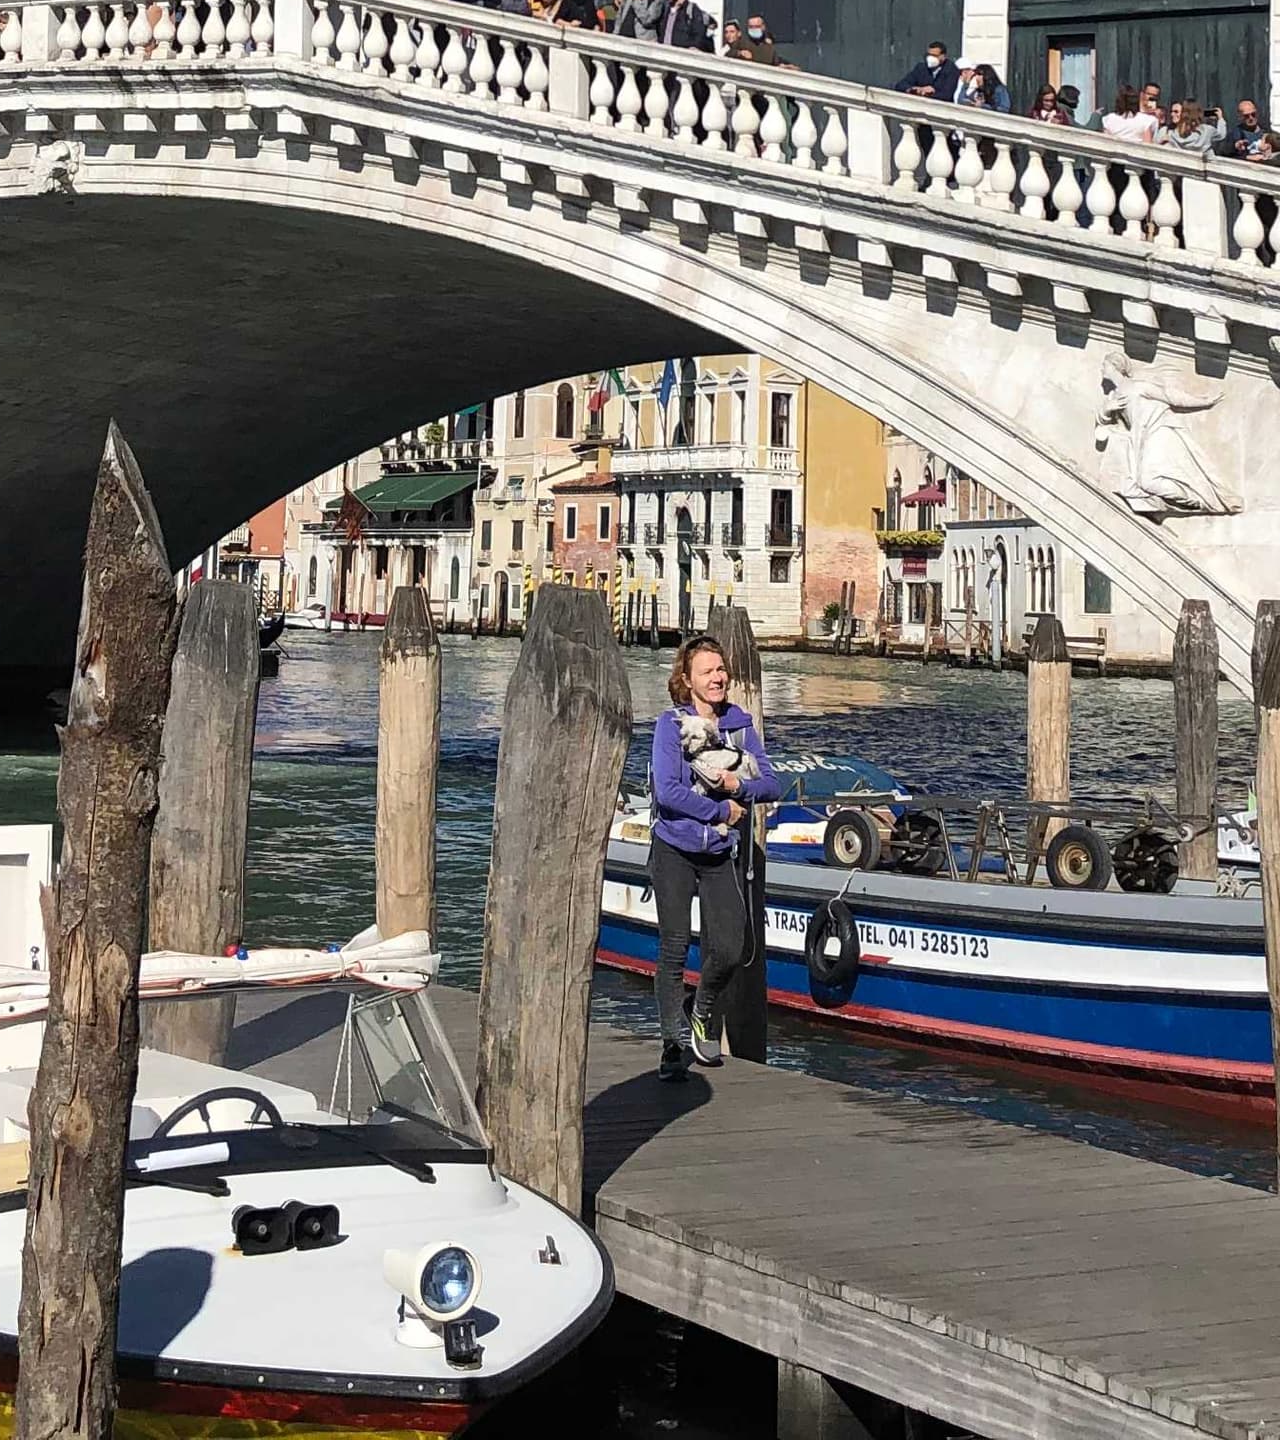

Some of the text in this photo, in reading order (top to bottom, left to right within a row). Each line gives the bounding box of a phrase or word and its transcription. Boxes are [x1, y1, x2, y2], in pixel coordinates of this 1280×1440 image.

[859, 923, 884, 946] TEL.
[888, 926, 915, 950] 041
[920, 931, 990, 959] 5285123
